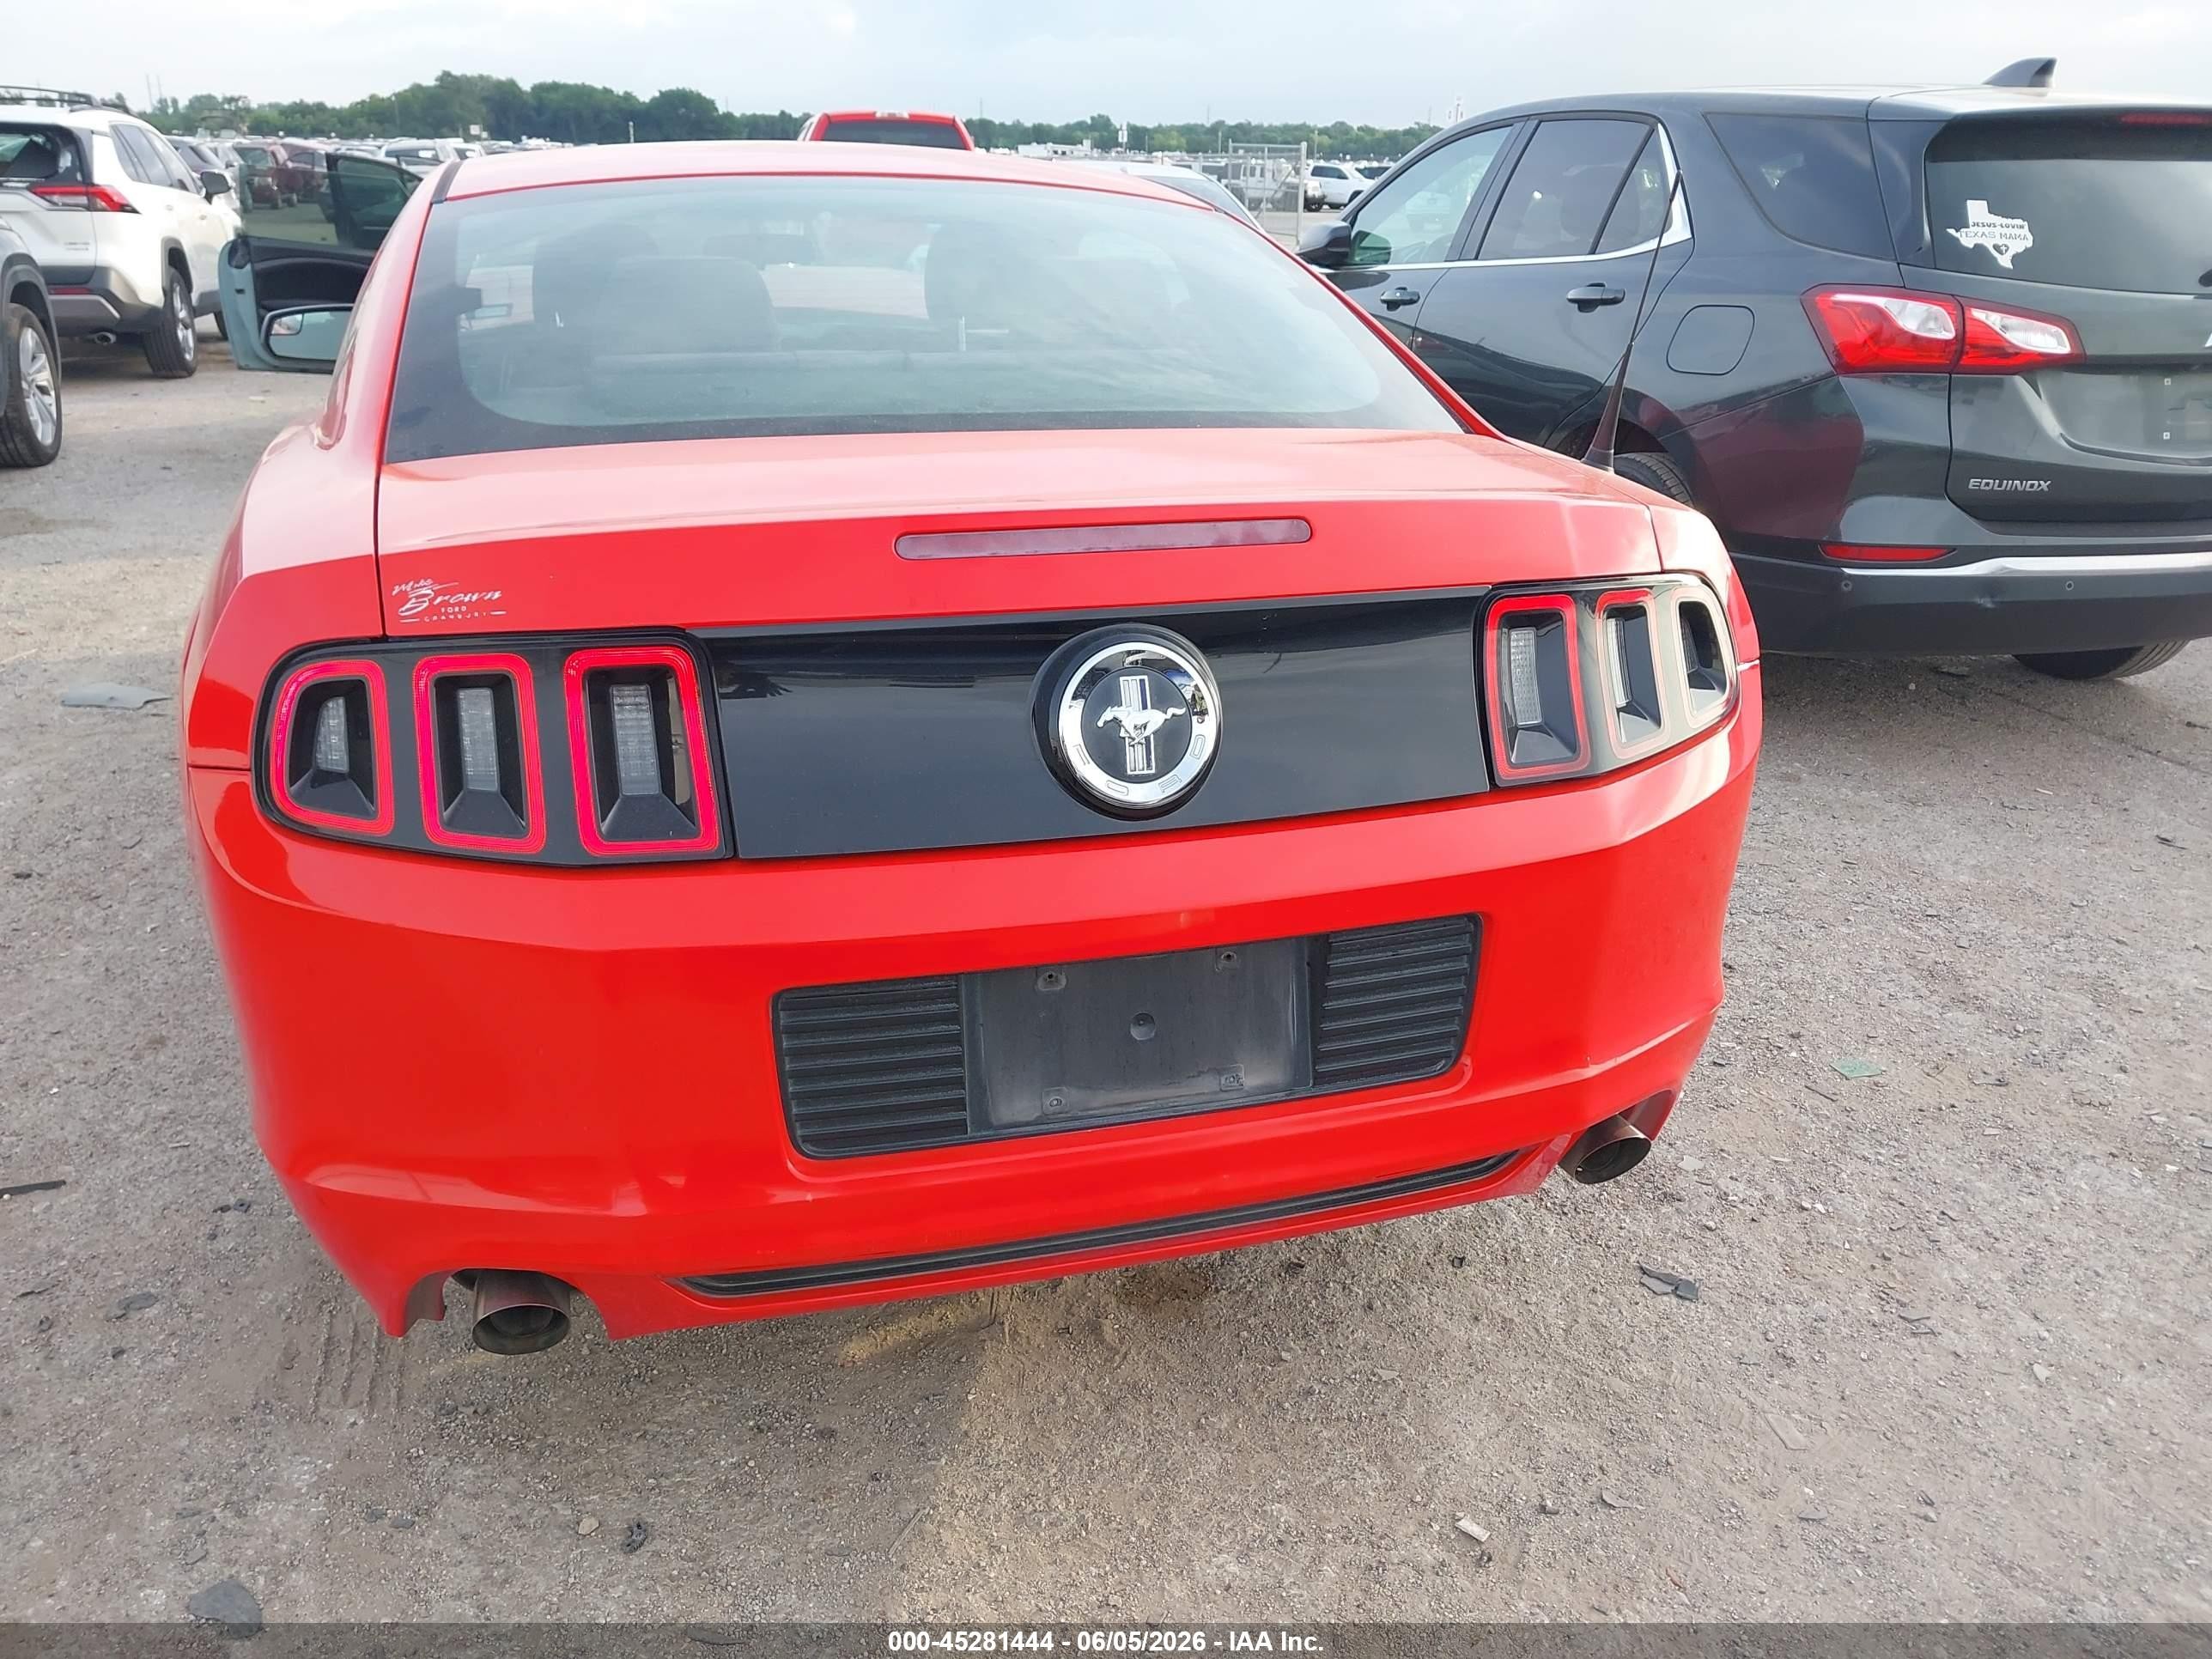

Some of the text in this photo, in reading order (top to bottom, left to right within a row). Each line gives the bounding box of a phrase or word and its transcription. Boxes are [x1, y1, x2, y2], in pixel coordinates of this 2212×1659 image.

[1959, 230, 2029, 241] TEXAS MAMA
[1968, 479, 2051, 491] EQUINOX
[398, 589, 503, 616] Brown
[1073, 735, 1206, 796] FORD
